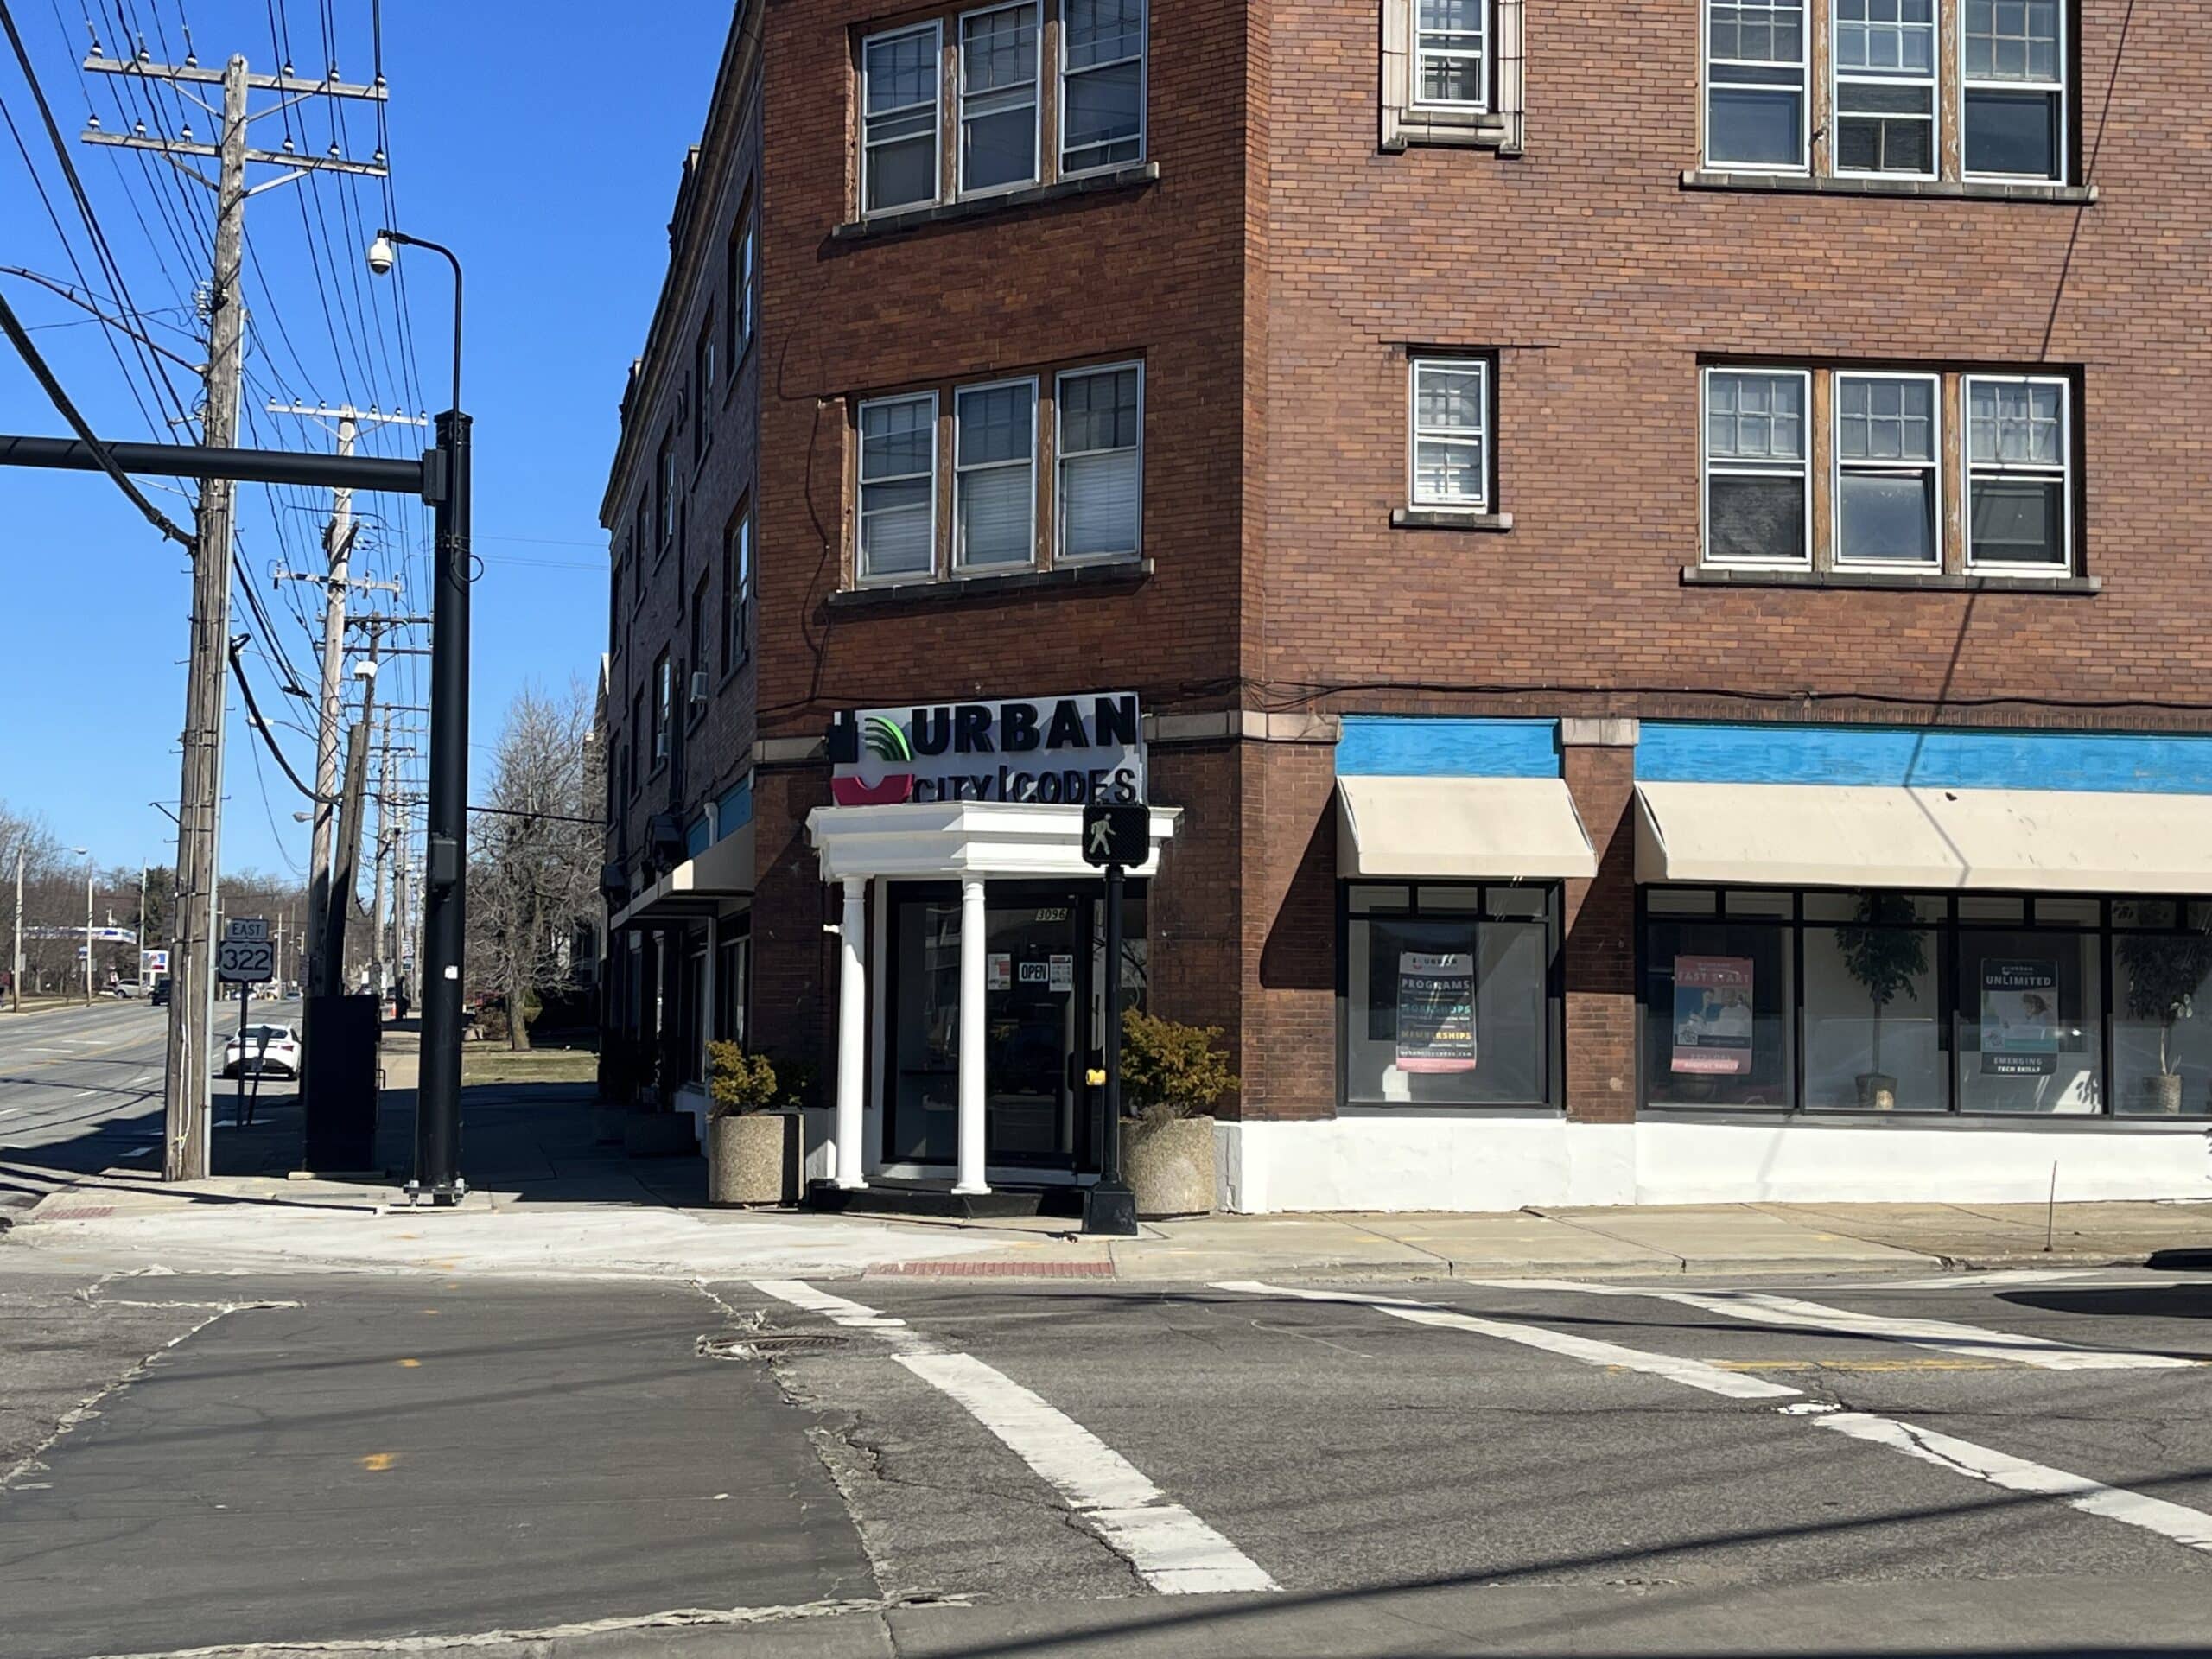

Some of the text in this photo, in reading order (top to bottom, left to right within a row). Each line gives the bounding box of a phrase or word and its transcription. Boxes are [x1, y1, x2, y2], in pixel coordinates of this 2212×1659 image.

[912, 696, 1136, 755] URBAN
[1039, 908, 1065, 920] 3096
[232, 923, 262, 936] EAST
[222, 948, 270, 970] 322
[1021, 964, 1046, 979] OPEN
[1677, 971, 1707, 982] FAST
[1402, 979, 1470, 989] PROGRAMS
[1986, 976, 2051, 986] UNLIMITED
[1401, 1004, 1471, 1015] ORHOPS
[1401, 1030, 1471, 1040] MEMBRSHIPS
